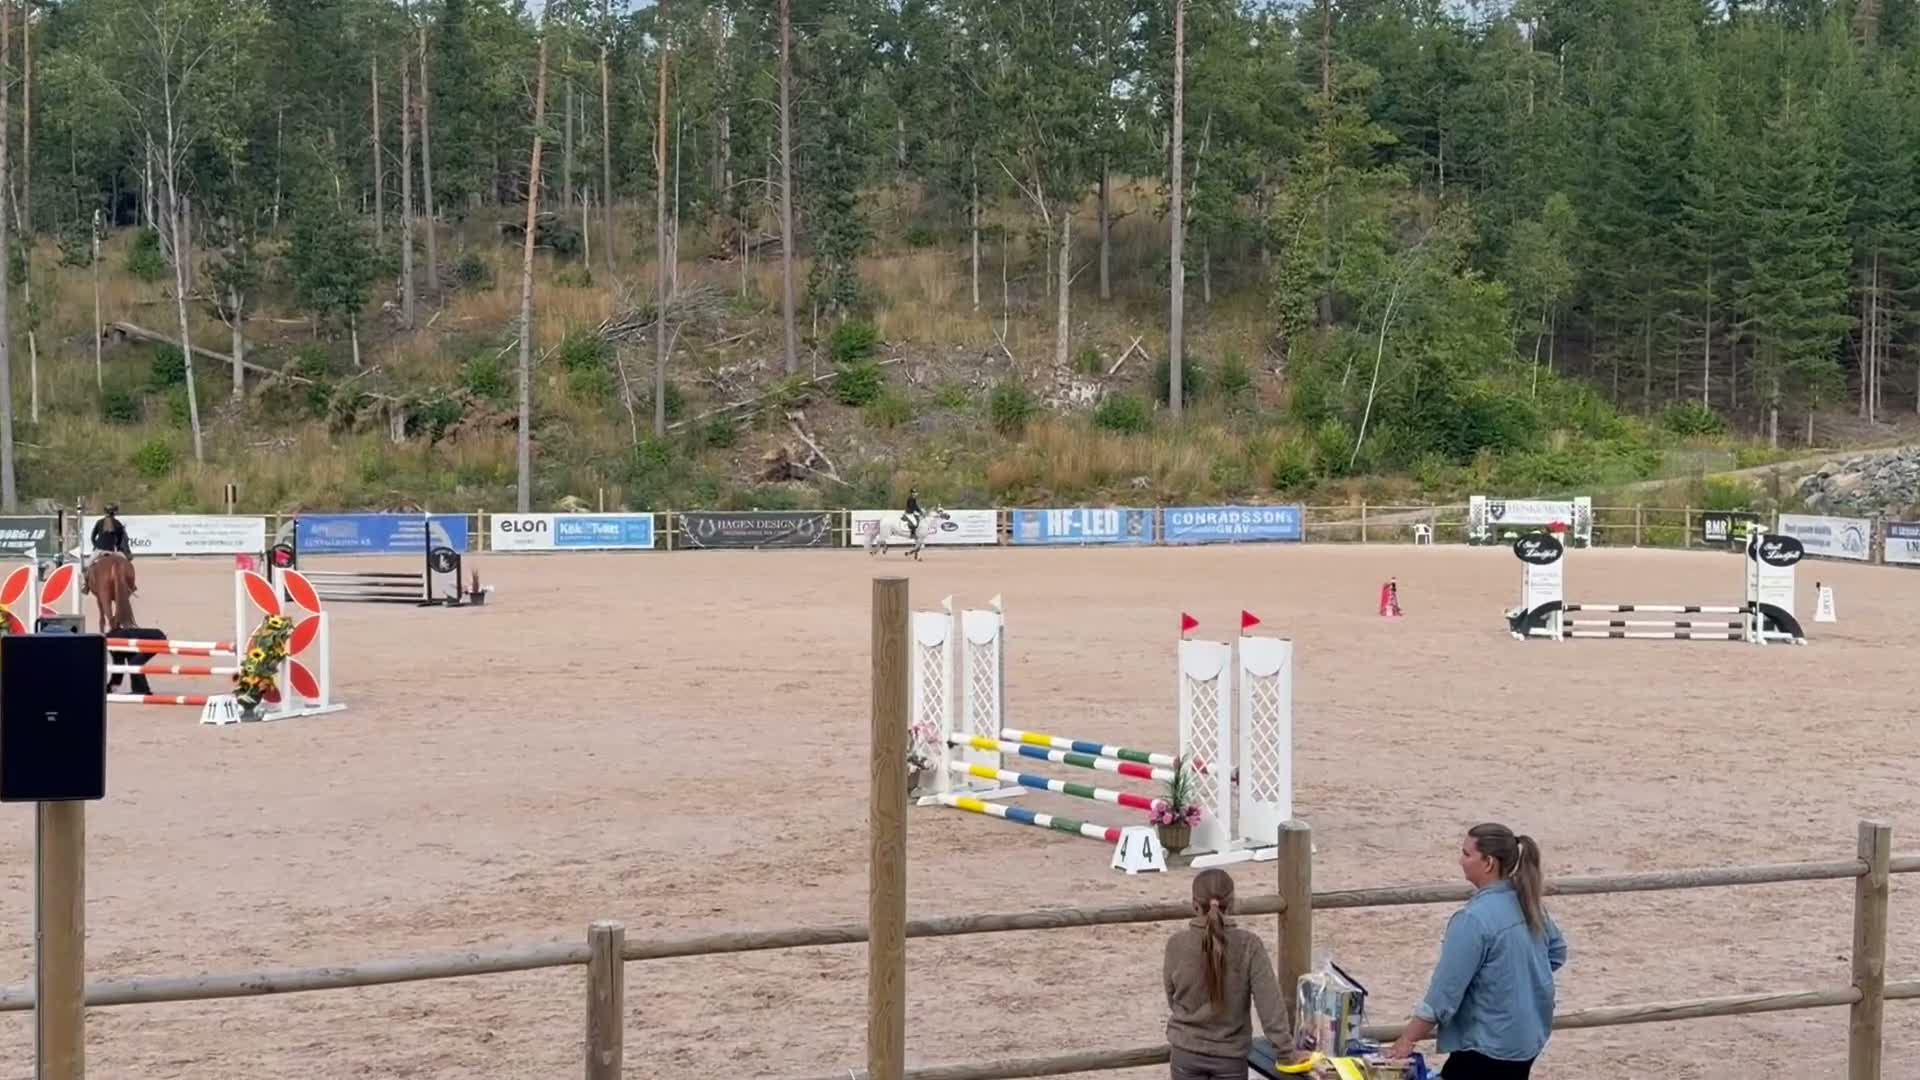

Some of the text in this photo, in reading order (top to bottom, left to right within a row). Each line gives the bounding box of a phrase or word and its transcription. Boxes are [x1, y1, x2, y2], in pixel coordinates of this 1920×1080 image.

[717, 519, 796, 529] HAGEN DESIGN
[1705, 520, 1727, 534] BMR
[224, 701, 234, 718] 11
[1120, 835, 1129, 863] 4
[1142, 836, 1153, 863] 4
